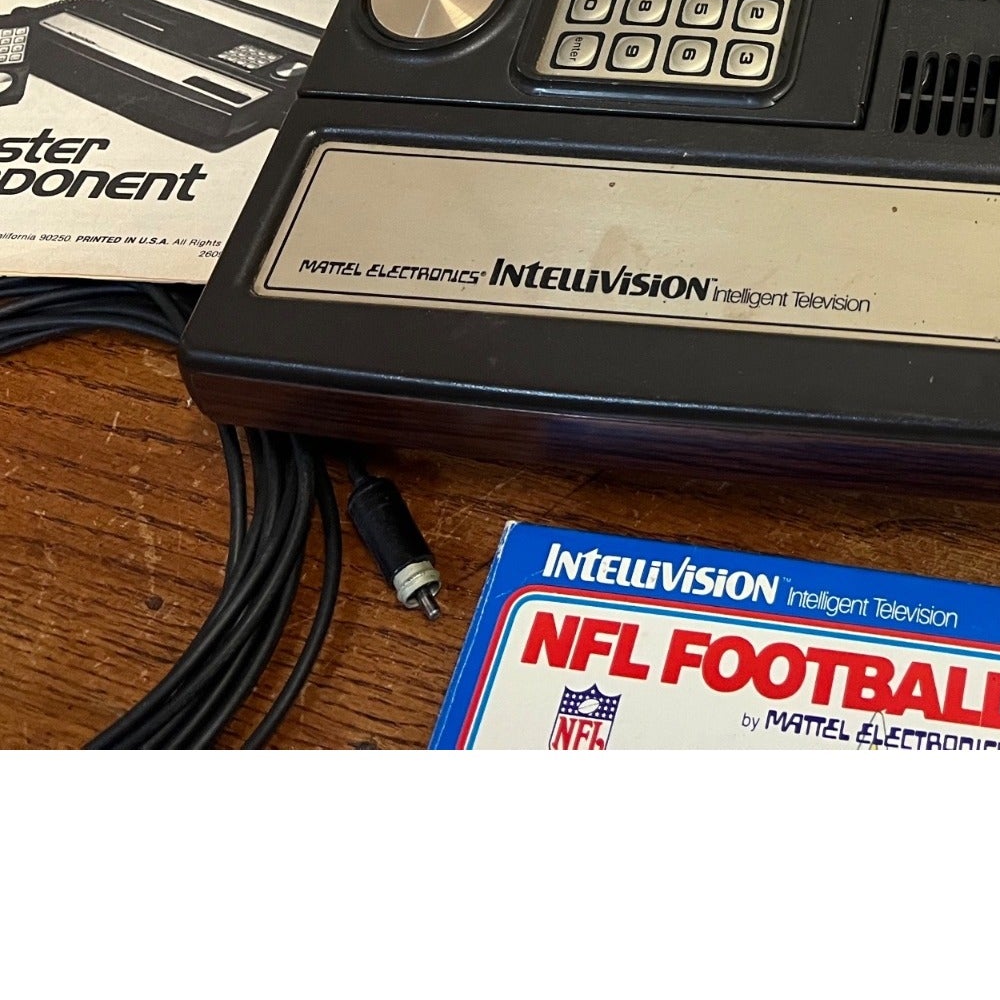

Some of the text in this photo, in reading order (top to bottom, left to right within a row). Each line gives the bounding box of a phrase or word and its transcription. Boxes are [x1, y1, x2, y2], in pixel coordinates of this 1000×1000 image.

[569, 36, 583, 63] enter
[75, 235, 122, 244] PRINTED
[124, 236, 137, 244] IN
[138, 237, 170, 245] U.S.A.
[172, 238, 188, 246] All
[189, 238, 222, 249] Rights
[299, 259, 362, 277] MATTEL
[365, 263, 481, 285] ELECTRONICS
[712, 286, 788, 309] Intelligent
[792, 291, 871, 313] Television
[786, 586, 870, 617] Intelligent
[872, 597, 959, 629] Television
[520, 611, 650, 682] NFL
[551, 715, 605, 750] NFL
[741, 712, 760, 732] by
[765, 709, 851, 741] MATTEL
